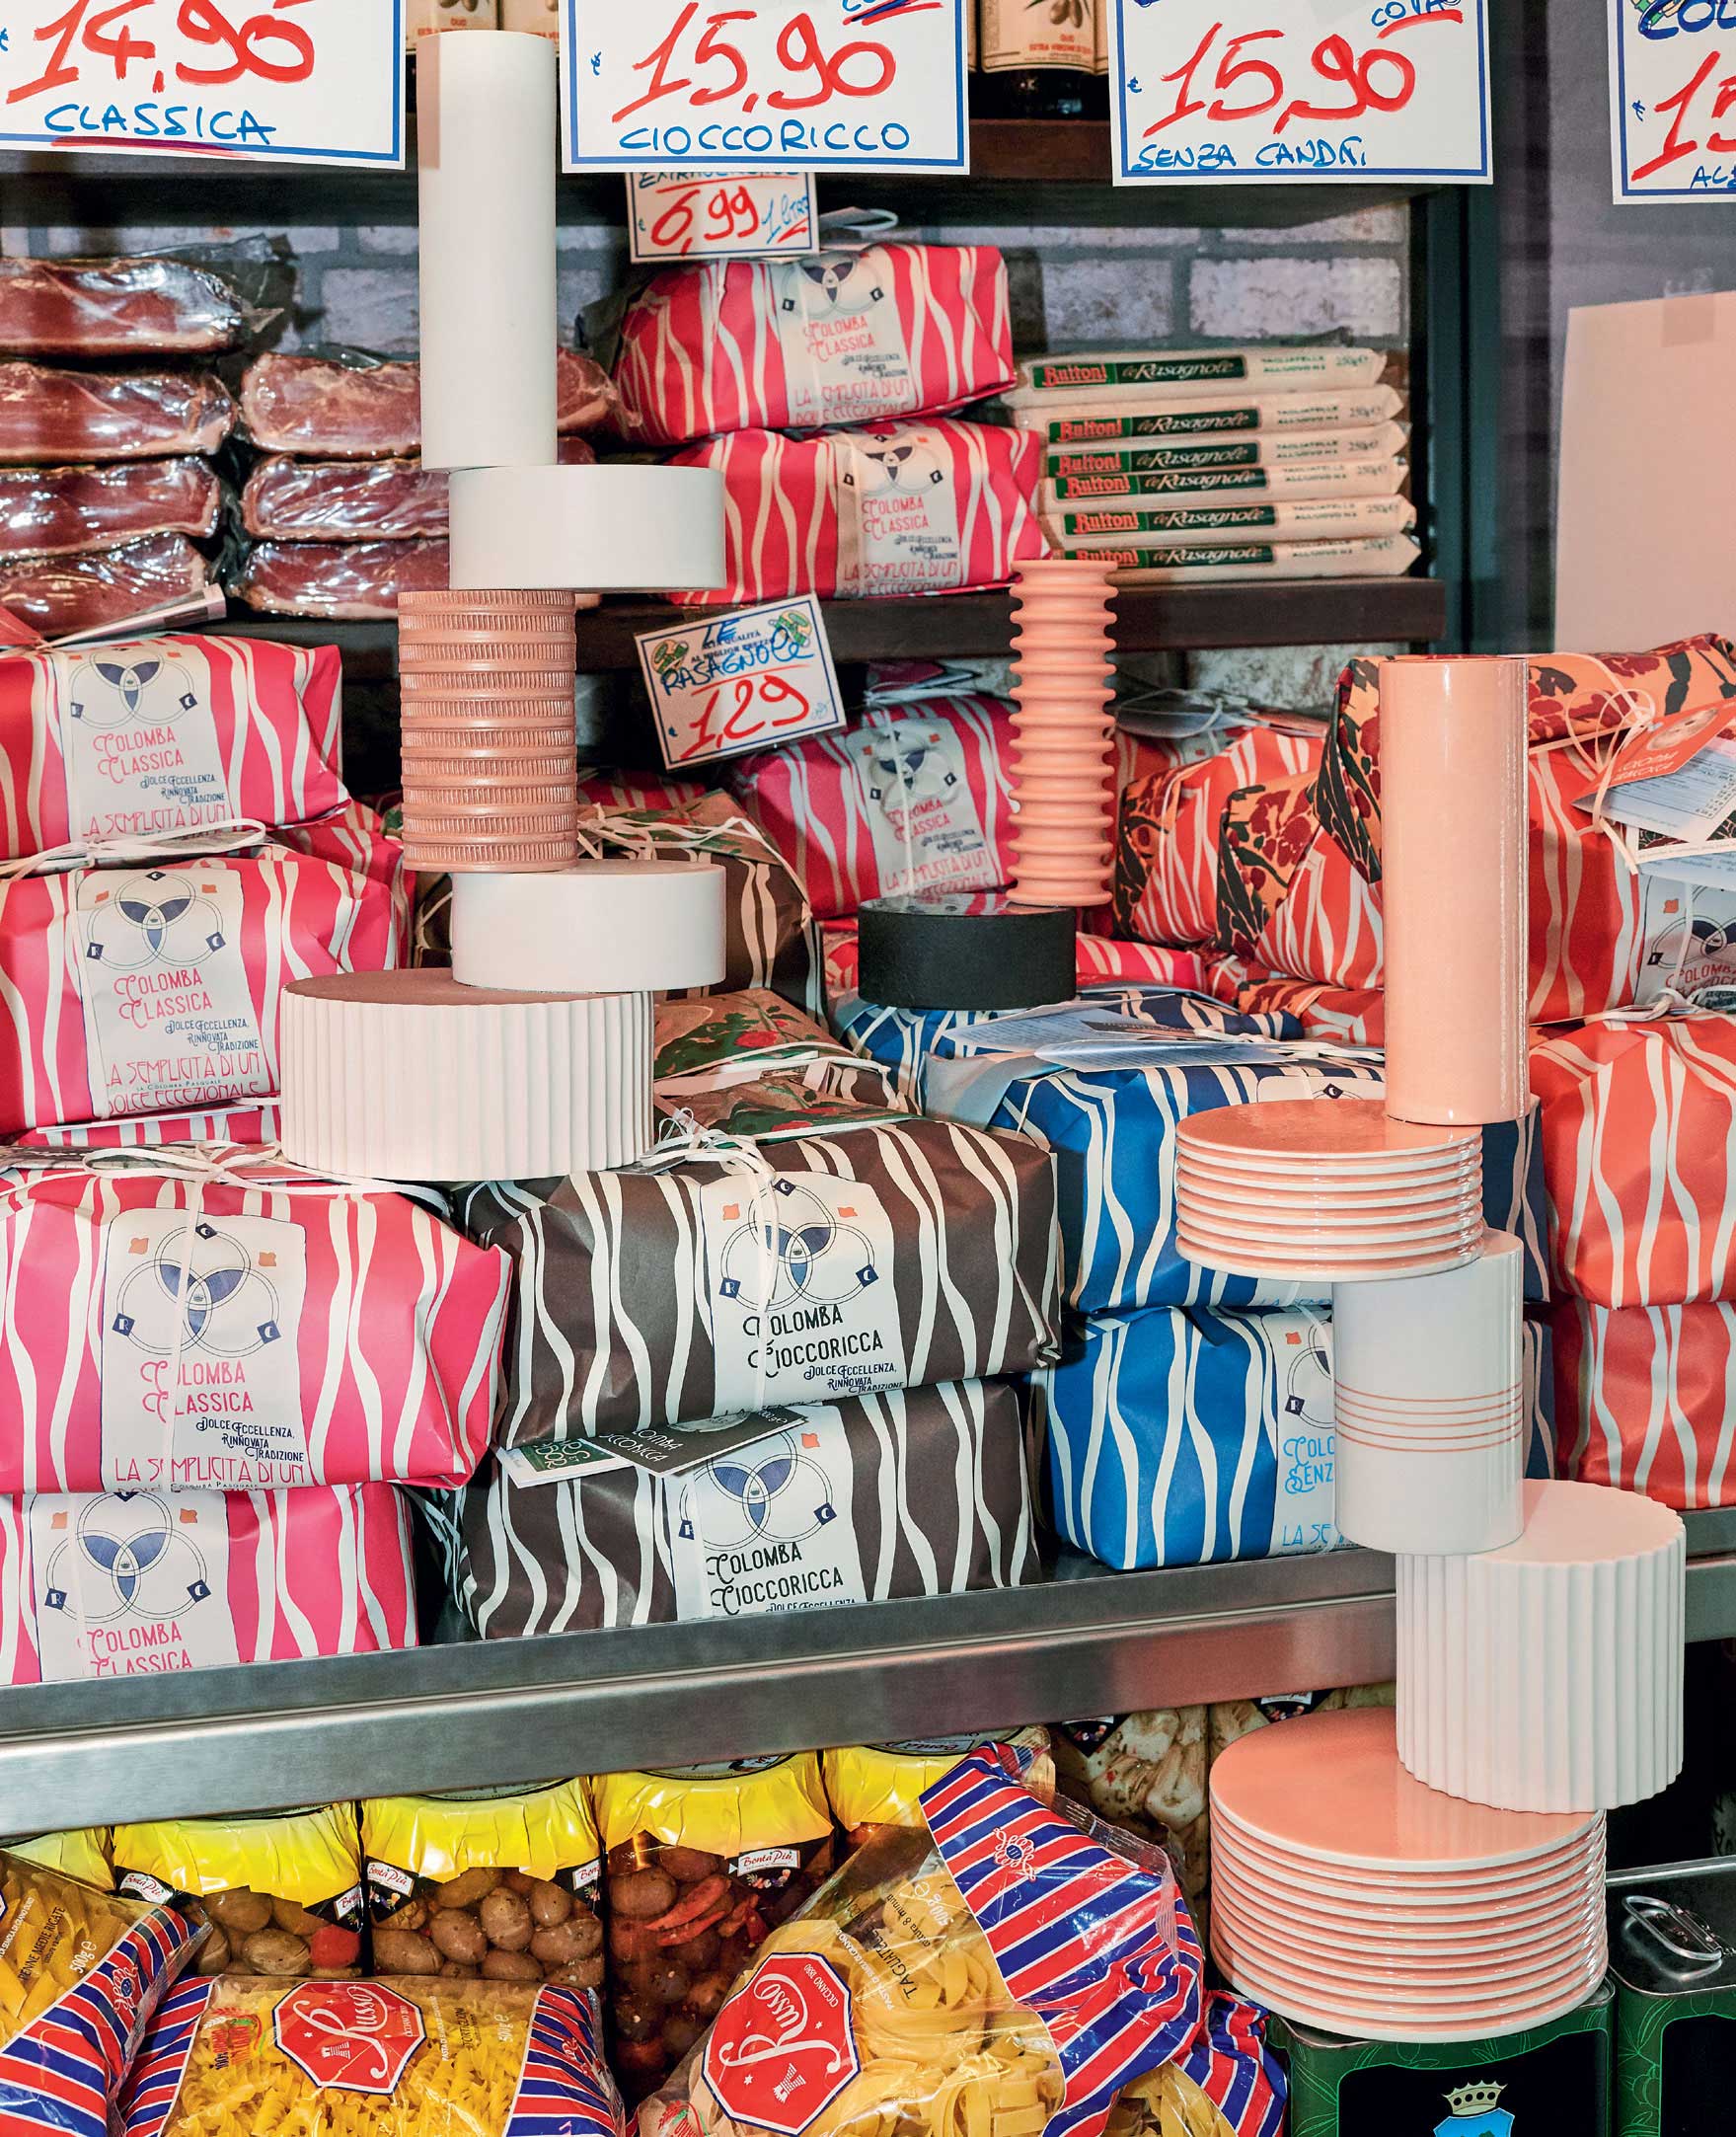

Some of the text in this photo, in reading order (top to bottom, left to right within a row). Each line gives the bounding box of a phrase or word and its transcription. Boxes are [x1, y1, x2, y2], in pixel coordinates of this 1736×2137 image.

[612, 2, 897, 123] 15,90
[1143, 23, 1416, 138] 15,90
[44, 103, 276, 145] CLASSICA
[619, 118, 910, 155] CIOCCORICCO
[1132, 144, 1236, 172] SENZA
[650, 185, 760, 257] 6,99
[1042, 362, 1107, 387] Buitoni
[1057, 419, 1122, 442] Buitoni
[1056, 453, 1121, 476] Buitoni
[1065, 474, 1130, 497] Buitoni
[862, 496, 924, 518] COLOMBA
[863, 514, 929, 541] CLASSICA
[1073, 511, 1139, 534] Buitoni
[680, 675, 809, 760] 1,29
[93, 725, 176, 759] COLOMBA
[98, 749, 184, 784] CLASSICA
[113, 968, 202, 1004] COLOMBA
[119, 992, 212, 1029] CLASSICA
[165, 1020, 194, 1033] DOLCE
[220, 1053, 234, 1076] DI
[239, 1052, 260, 1075] UN
[803, 1365, 837, 1380] DOLCE
[827, 1377, 871, 1391] RINNOVATA
[195, 1416, 231, 1431] DOLCE
[221, 1433, 268, 1448] RINNOVATA
[245, 1446, 304, 1462] TRADIZIONE
[115, 1458, 141, 1482] LA
[258, 1462, 273, 1483] DI
[278, 1464, 303, 1483] UN
[1282, 1525, 1304, 1546] LA
[706, 1542, 802, 1585] COLOMBA
[711, 1566, 844, 1616] CIOCCORICCA
[77, 1621, 182, 1661] COLOMBA
